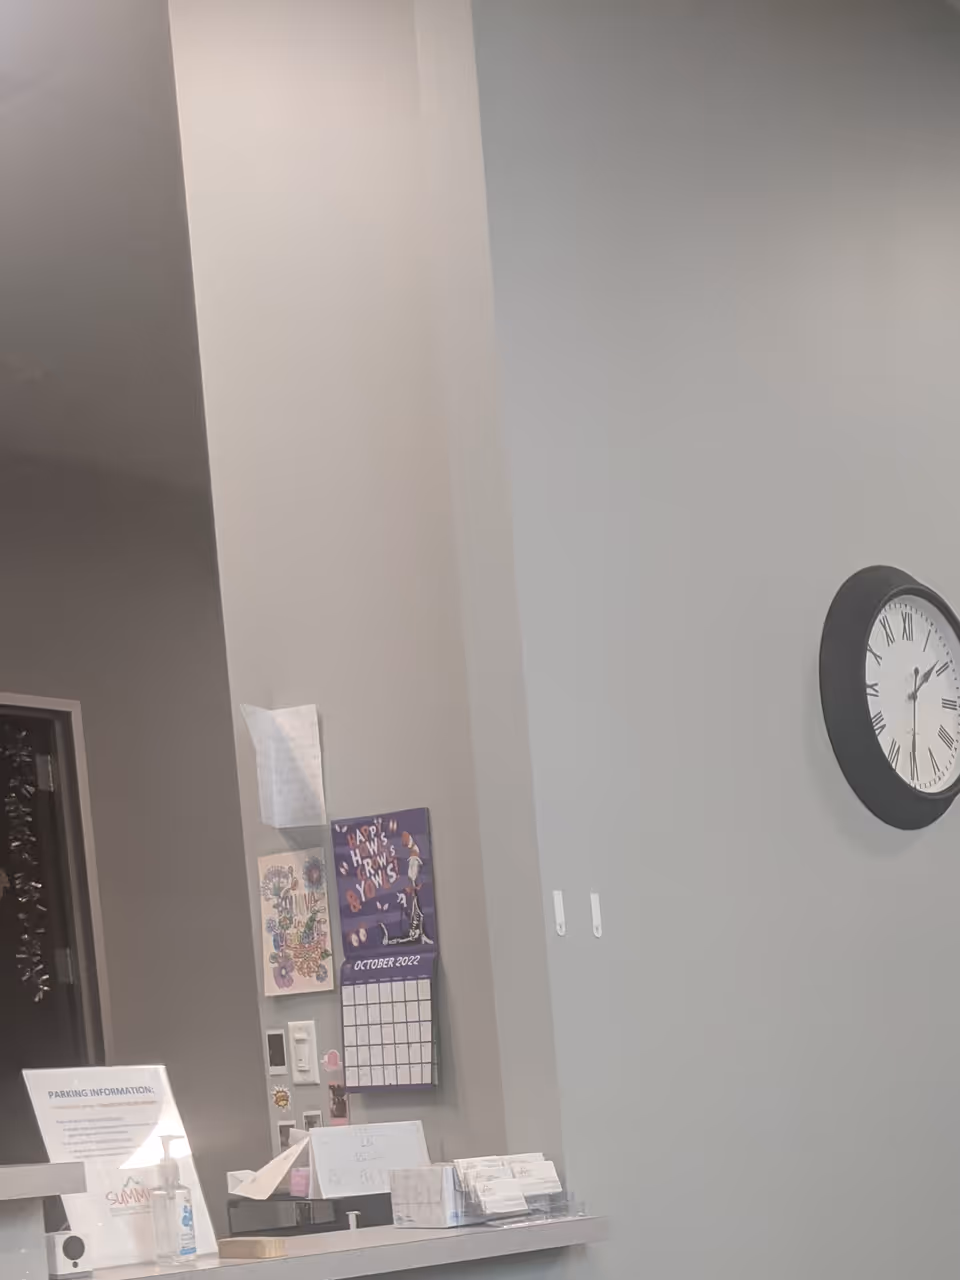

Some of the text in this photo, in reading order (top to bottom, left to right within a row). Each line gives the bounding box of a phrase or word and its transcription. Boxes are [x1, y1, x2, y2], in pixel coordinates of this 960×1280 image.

[354, 955, 421, 970] OCTOBER 2022
[48, 1086, 155, 1099] PARKING INFORMATION:
